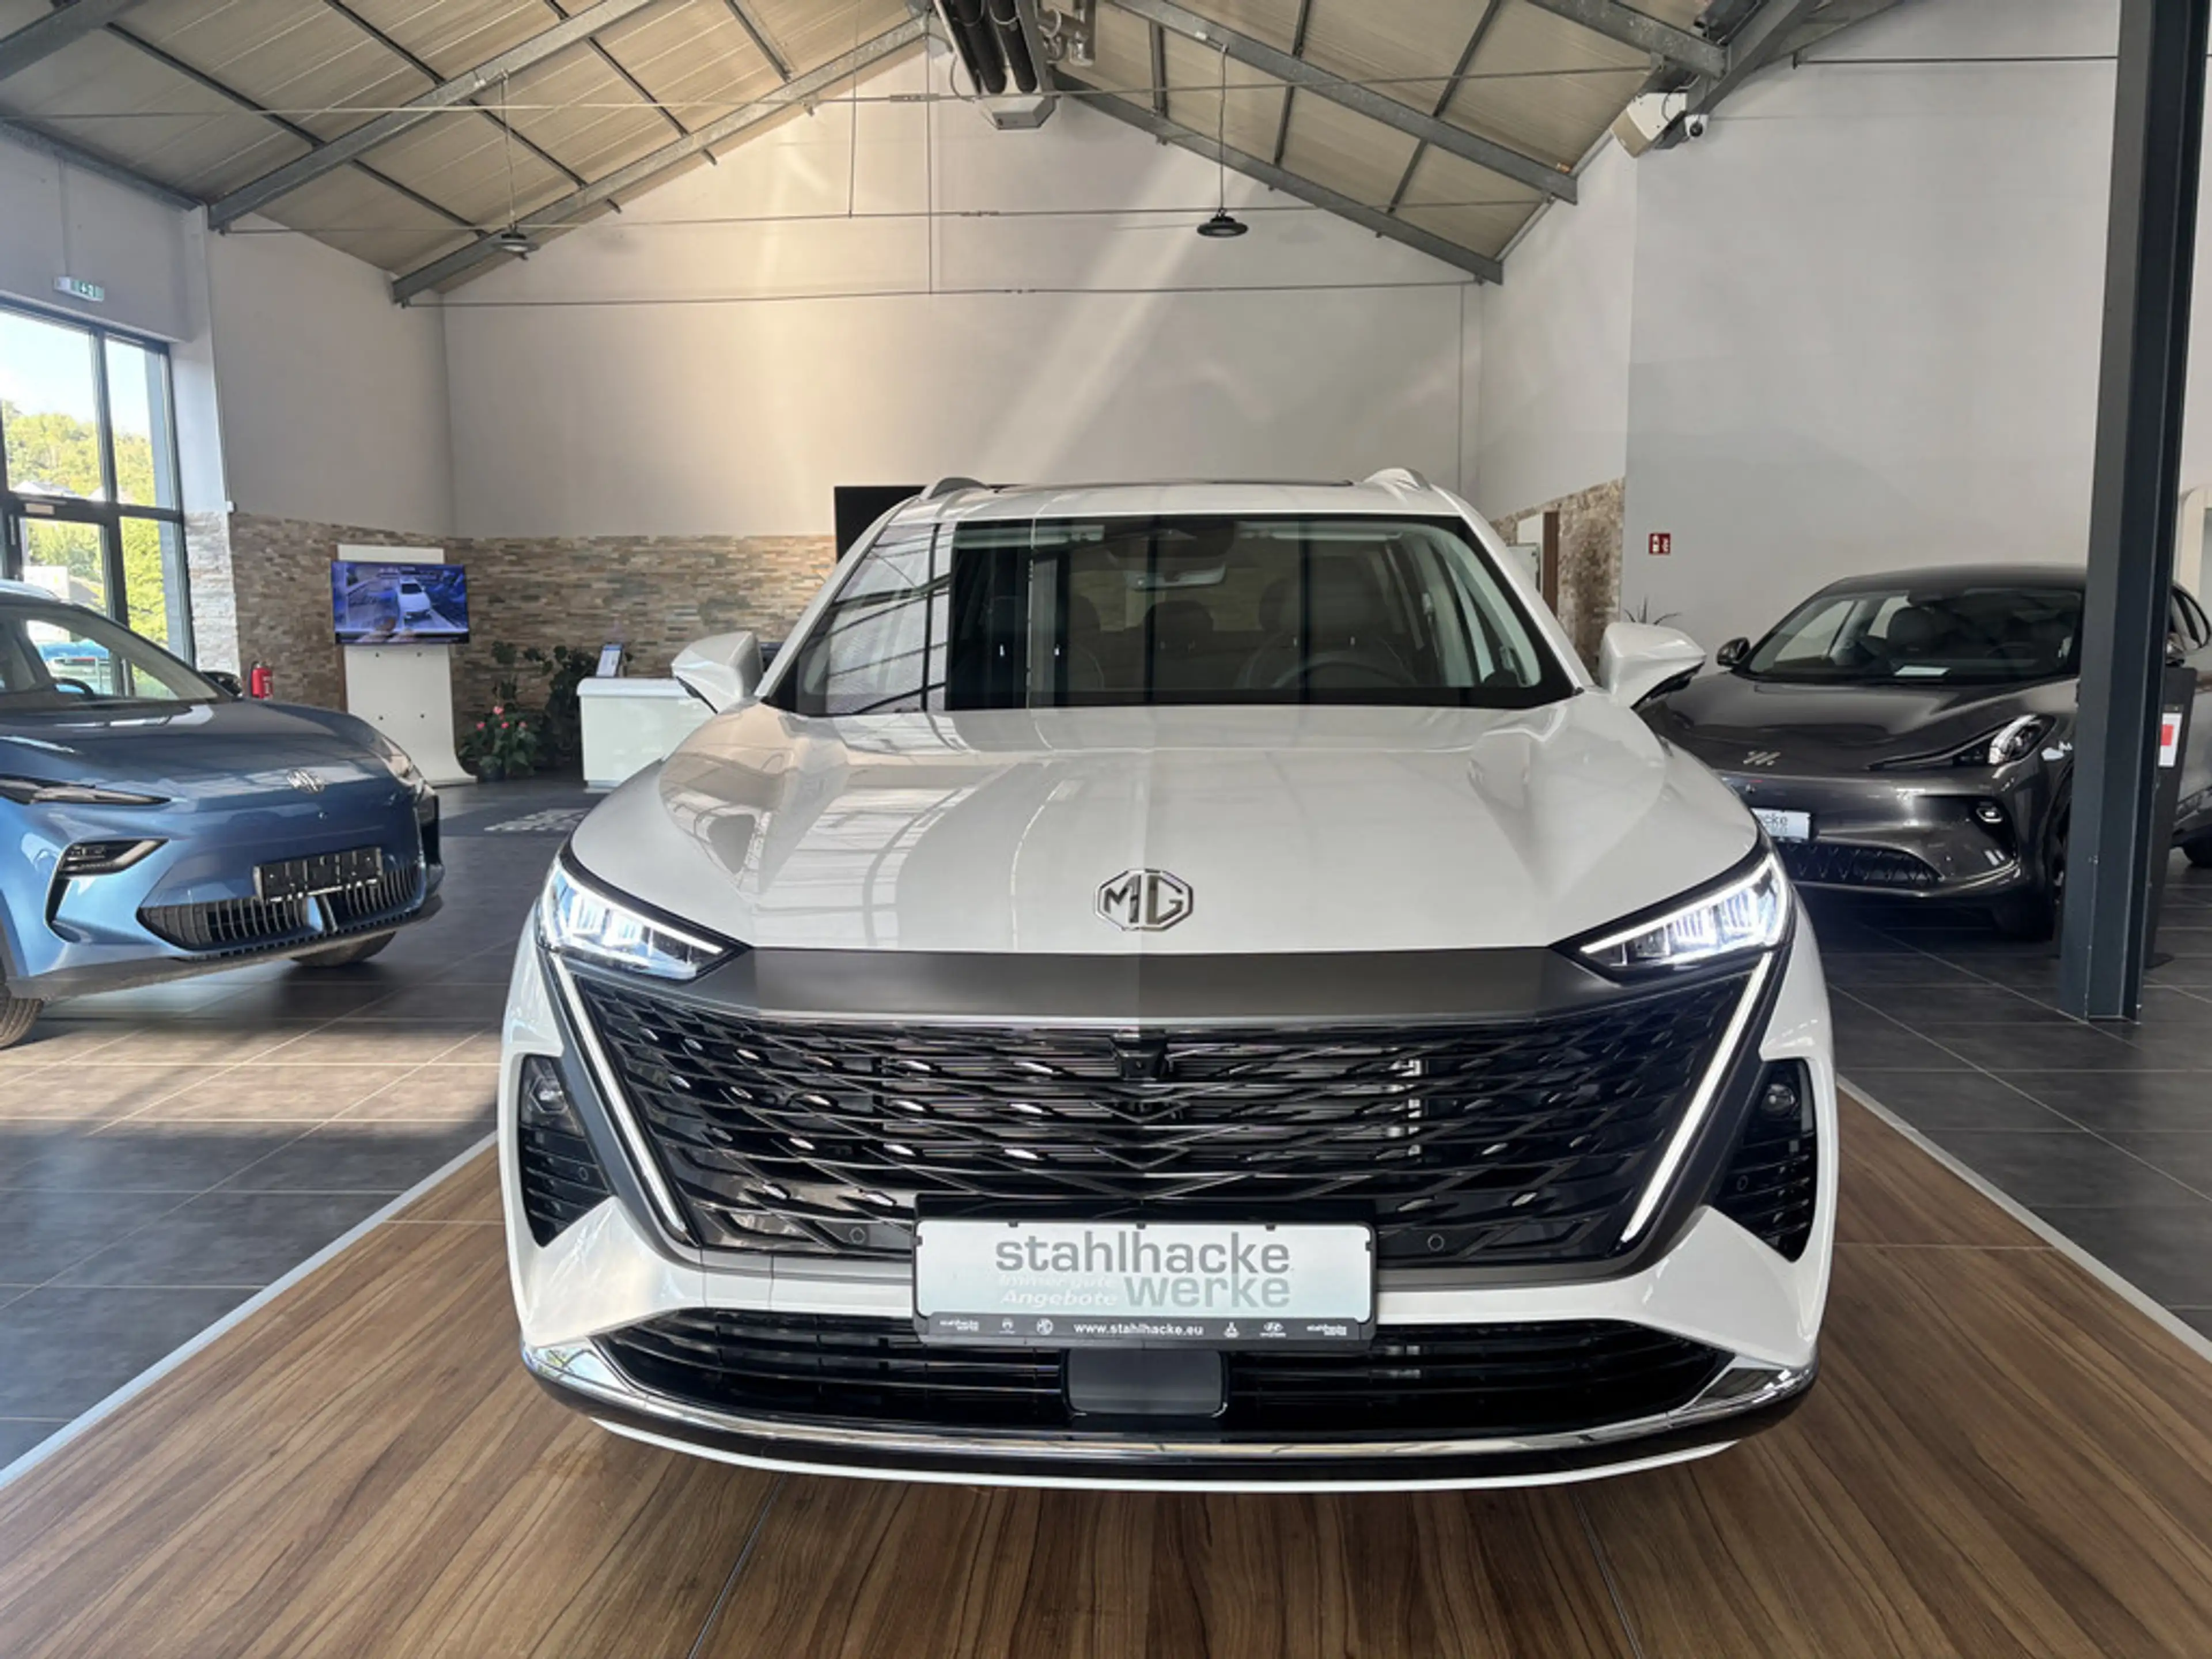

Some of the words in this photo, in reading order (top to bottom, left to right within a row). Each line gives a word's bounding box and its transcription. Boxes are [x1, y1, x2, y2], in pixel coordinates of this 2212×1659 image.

[1102, 873, 1185, 926] MG
[996, 1230, 1290, 1274] stahlhacke
[1000, 1290, 1118, 1308] Angebote
[1124, 1275, 1290, 1308] werke
[1073, 1323, 1204, 1336] www.stahlhacke.eu
